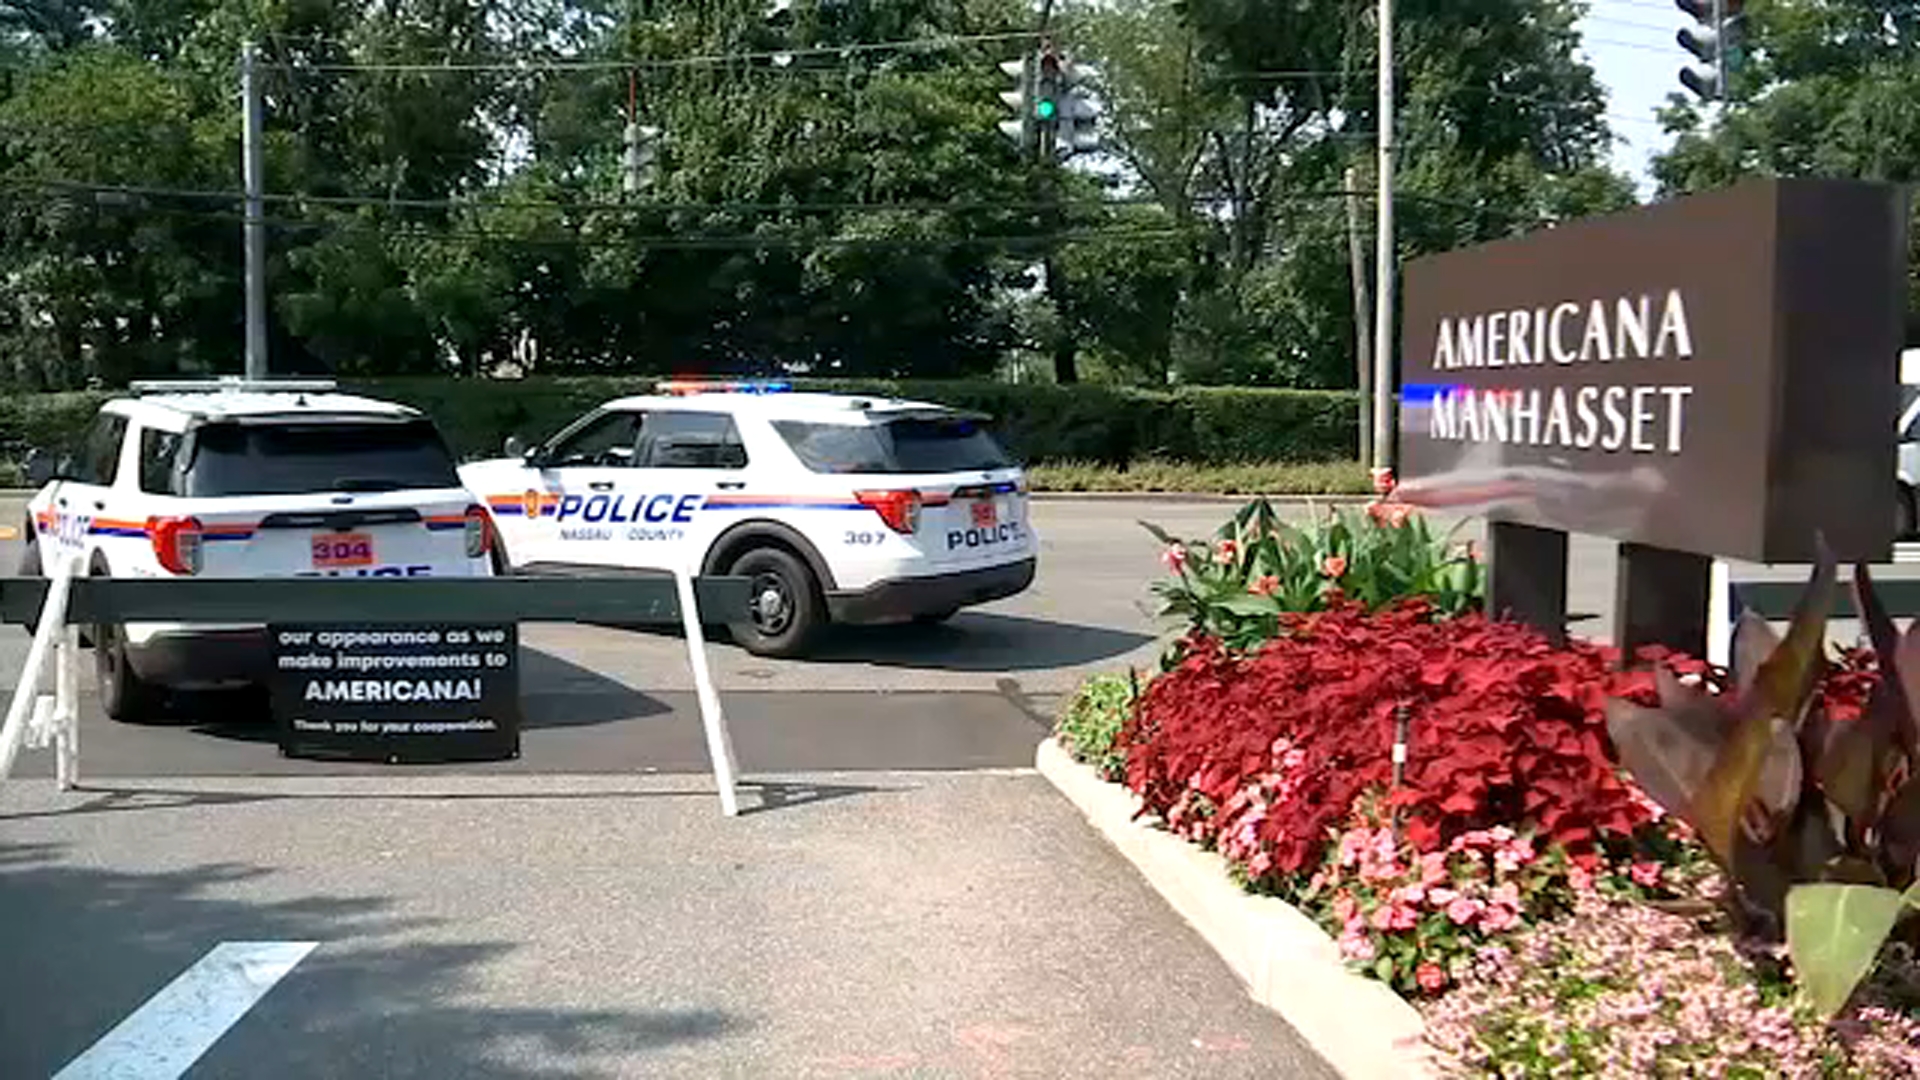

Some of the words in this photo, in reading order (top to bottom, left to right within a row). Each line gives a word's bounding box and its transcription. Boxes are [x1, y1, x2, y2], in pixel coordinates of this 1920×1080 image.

[1433, 289, 1693, 370] AMERICANA
[1430, 385, 1693, 453] MANHASSET
[557, 494, 702, 523] POLICE
[558, 528, 613, 541] NASSAU
[626, 527, 684, 541] COUNTY
[844, 531, 886, 545] 307
[312, 541, 370, 560] 304
[279, 630, 312, 645] our
[317, 630, 441, 648] appearance
[446, 630, 470, 644] as
[476, 630, 506, 644] we
[278, 653, 333, 669] make
[337, 651, 481, 671] improvements
[485, 652, 508, 667] to
[305, 678, 482, 701] AMERICANA!
[294, 719, 332, 731] Thank
[360, 720, 379, 732] for
[382, 721, 410, 733] your
